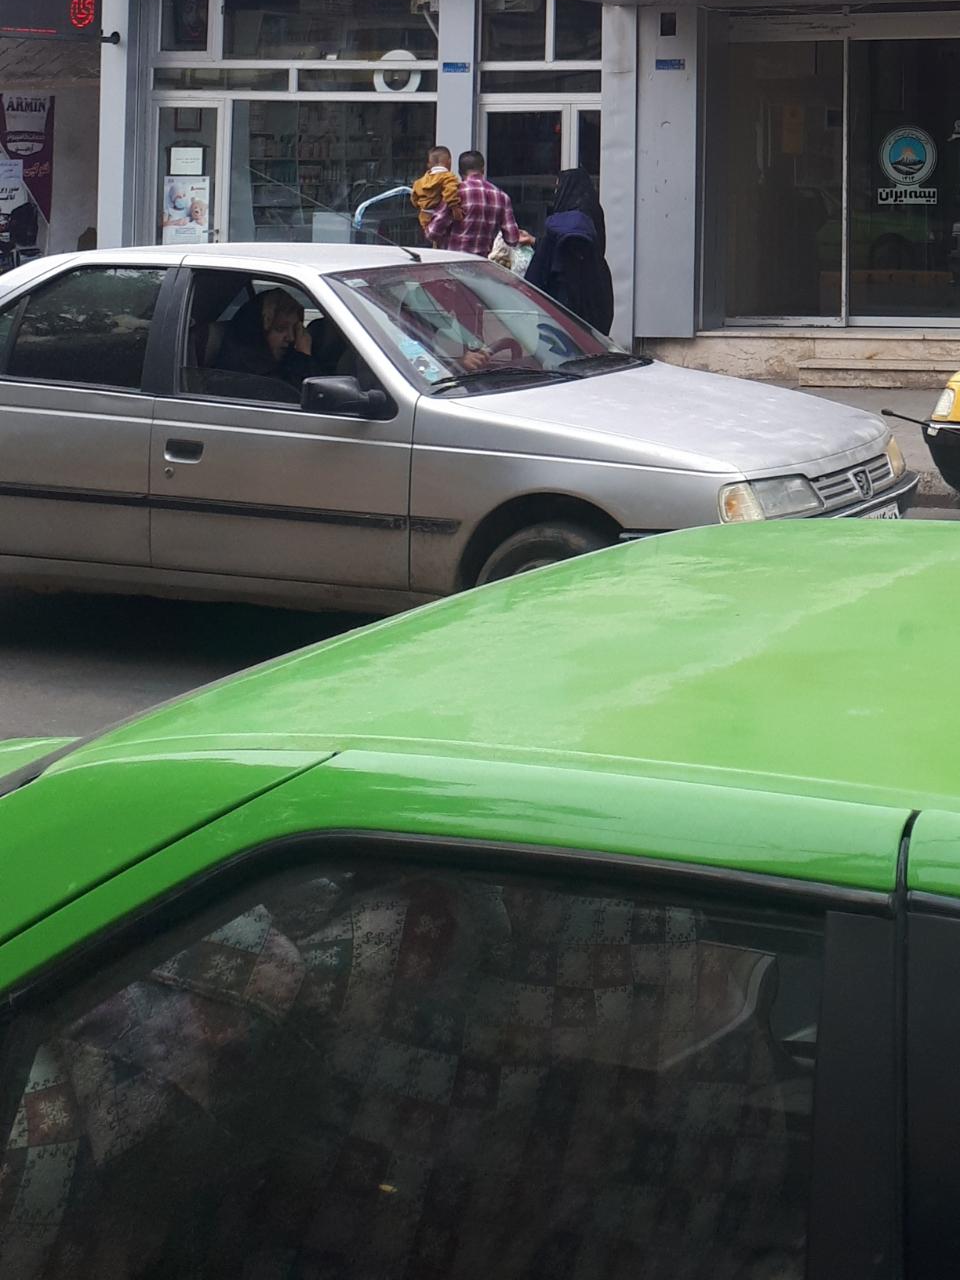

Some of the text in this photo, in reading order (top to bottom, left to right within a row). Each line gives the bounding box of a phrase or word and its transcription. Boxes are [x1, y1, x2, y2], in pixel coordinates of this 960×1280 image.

[6, 97, 47, 113] ARMIN
[879, 189, 936, 203] بیمه ایران
